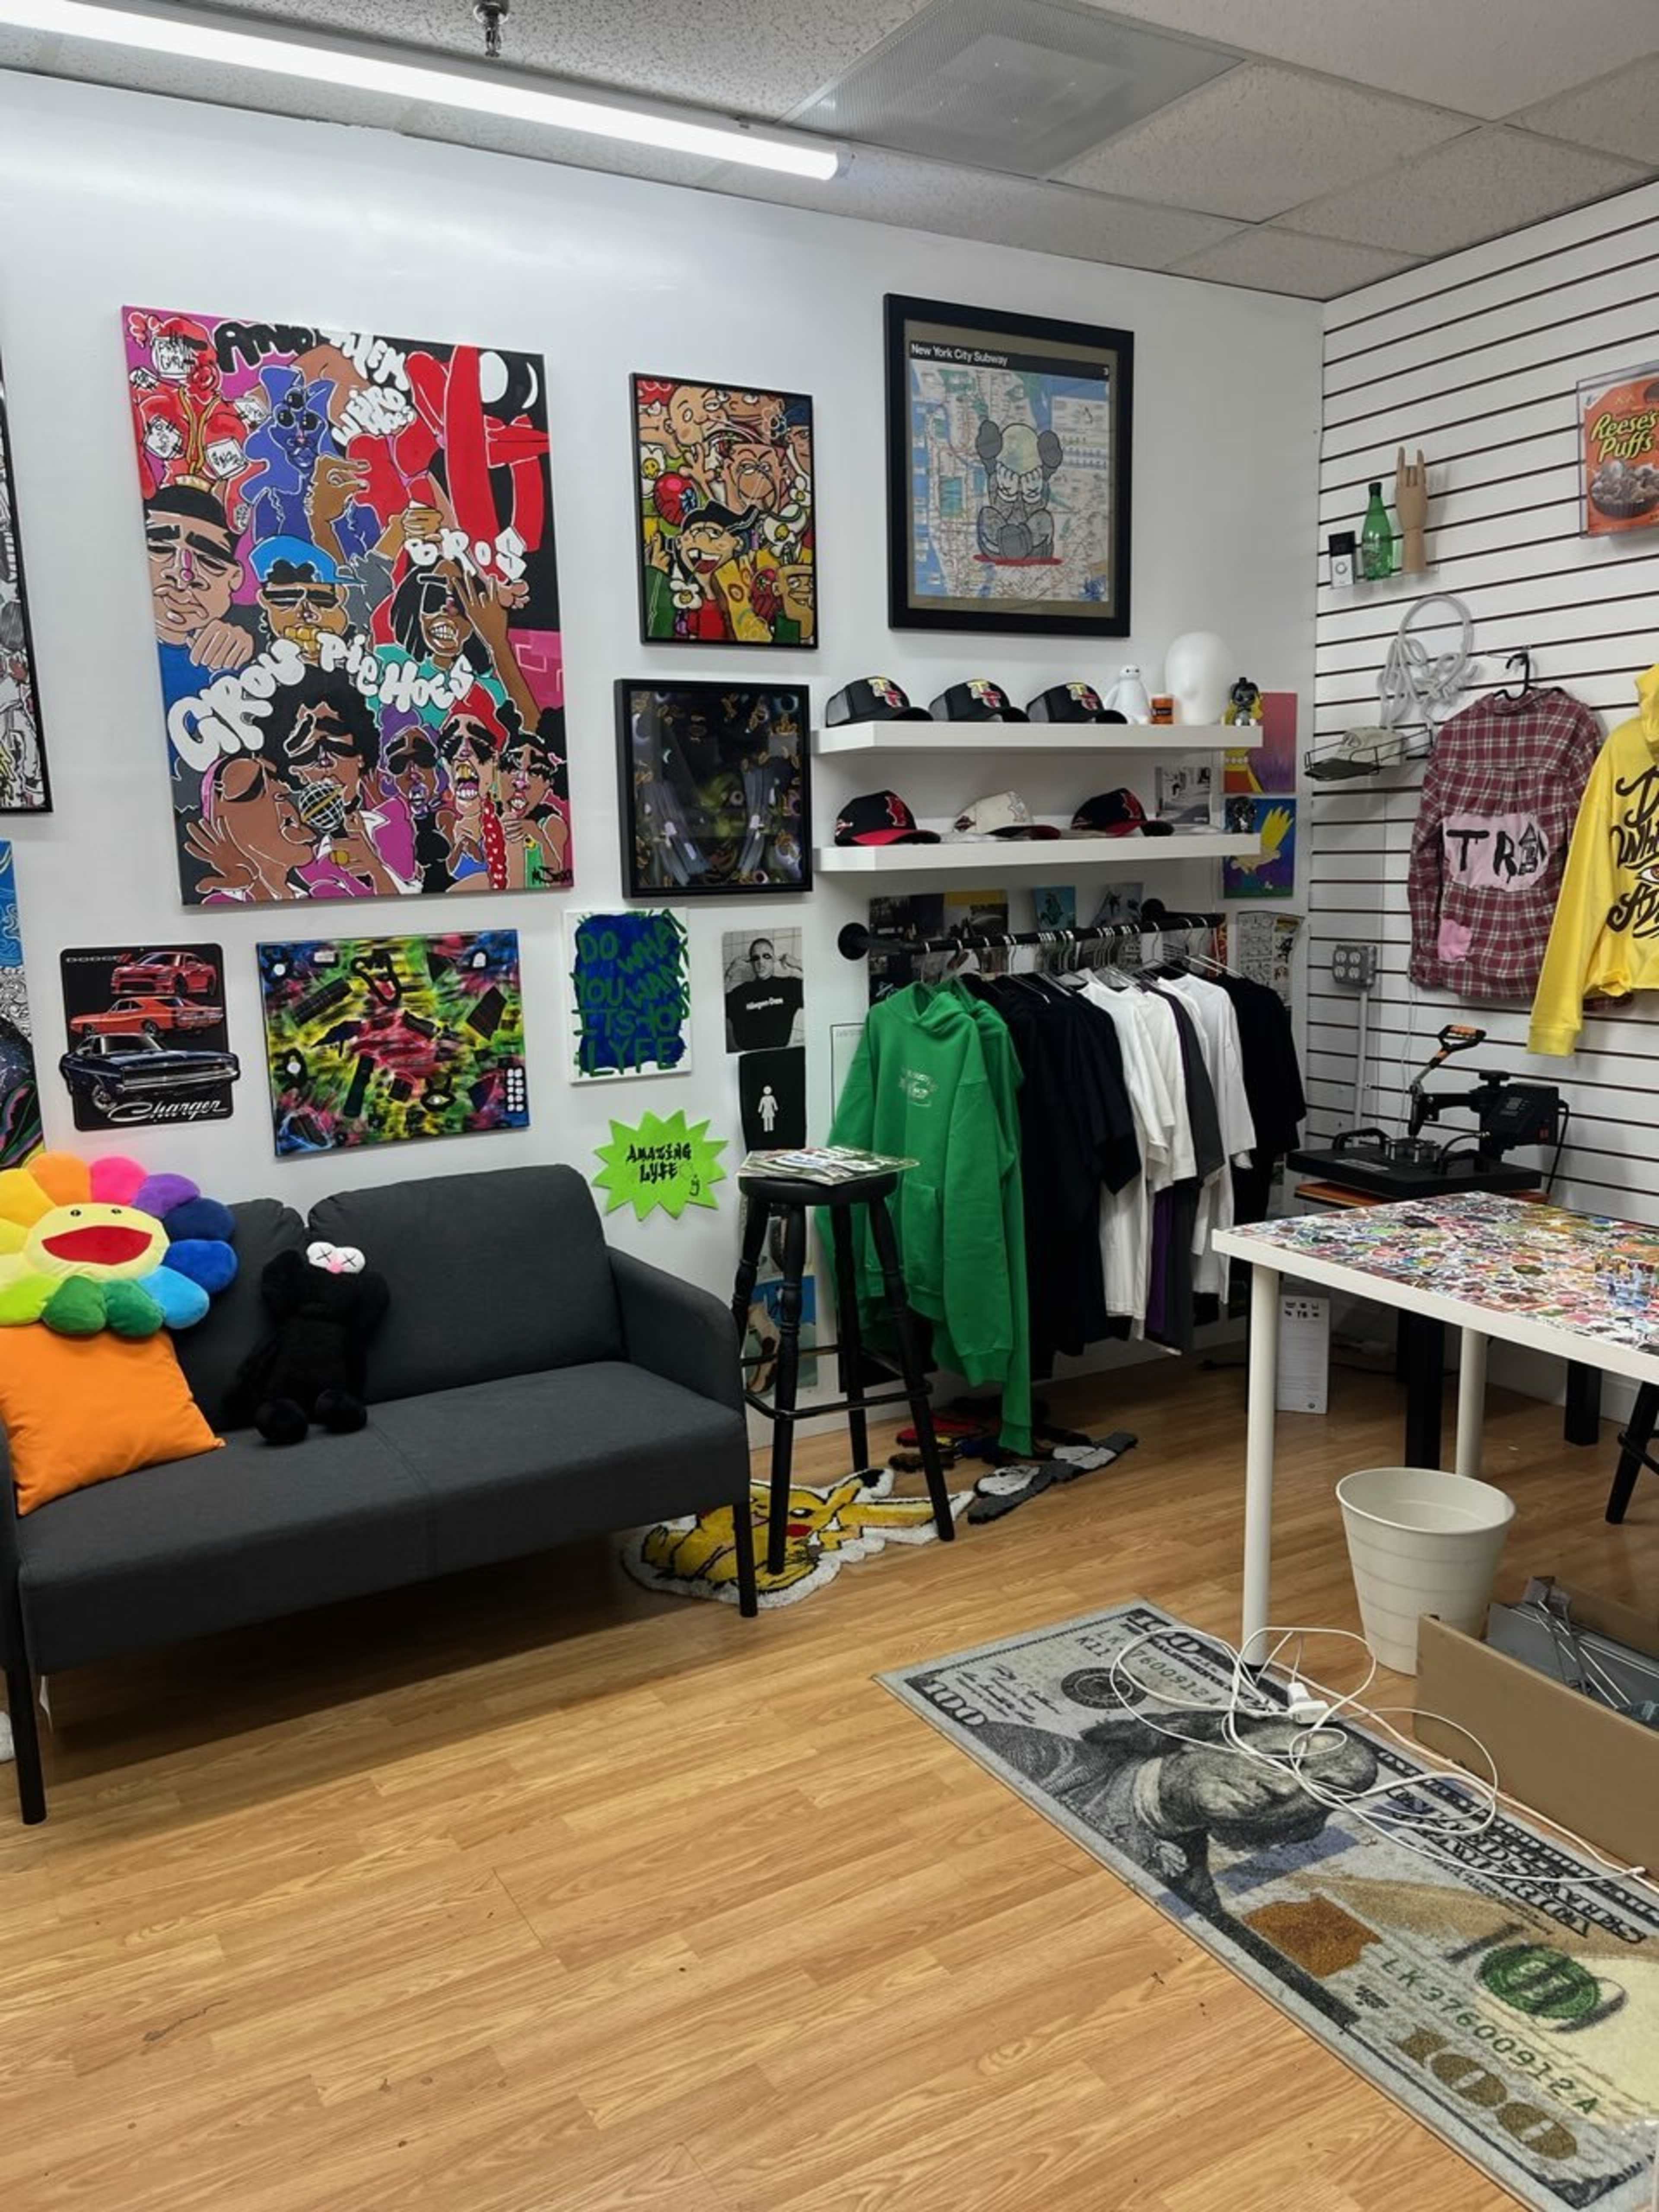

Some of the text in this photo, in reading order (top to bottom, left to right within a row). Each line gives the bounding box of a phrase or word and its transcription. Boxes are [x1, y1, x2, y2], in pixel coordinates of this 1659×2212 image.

[911, 343, 1008, 366] New York City Subway
[1590, 410, 1659, 442] Reese's
[1599, 431, 1654, 464] Puffs
[404, 526, 527, 581] BROS
[579, 931, 619, 964] DO
[570, 971, 625, 1007] YOU
[572, 1008, 637, 1038] ITS
[588, 1036, 680, 1077] LYFE
[108, 1100, 228, 1122] Charger
[626, 1143, 692, 1162] AMAZING
[639, 1162, 678, 1184] LYFE
[1076, 1636, 1111, 1657] K11
[1128, 1614, 1205, 1654] 100
[921, 1678, 988, 1726] 100
[1393, 2024, 1578, 2160] 100
